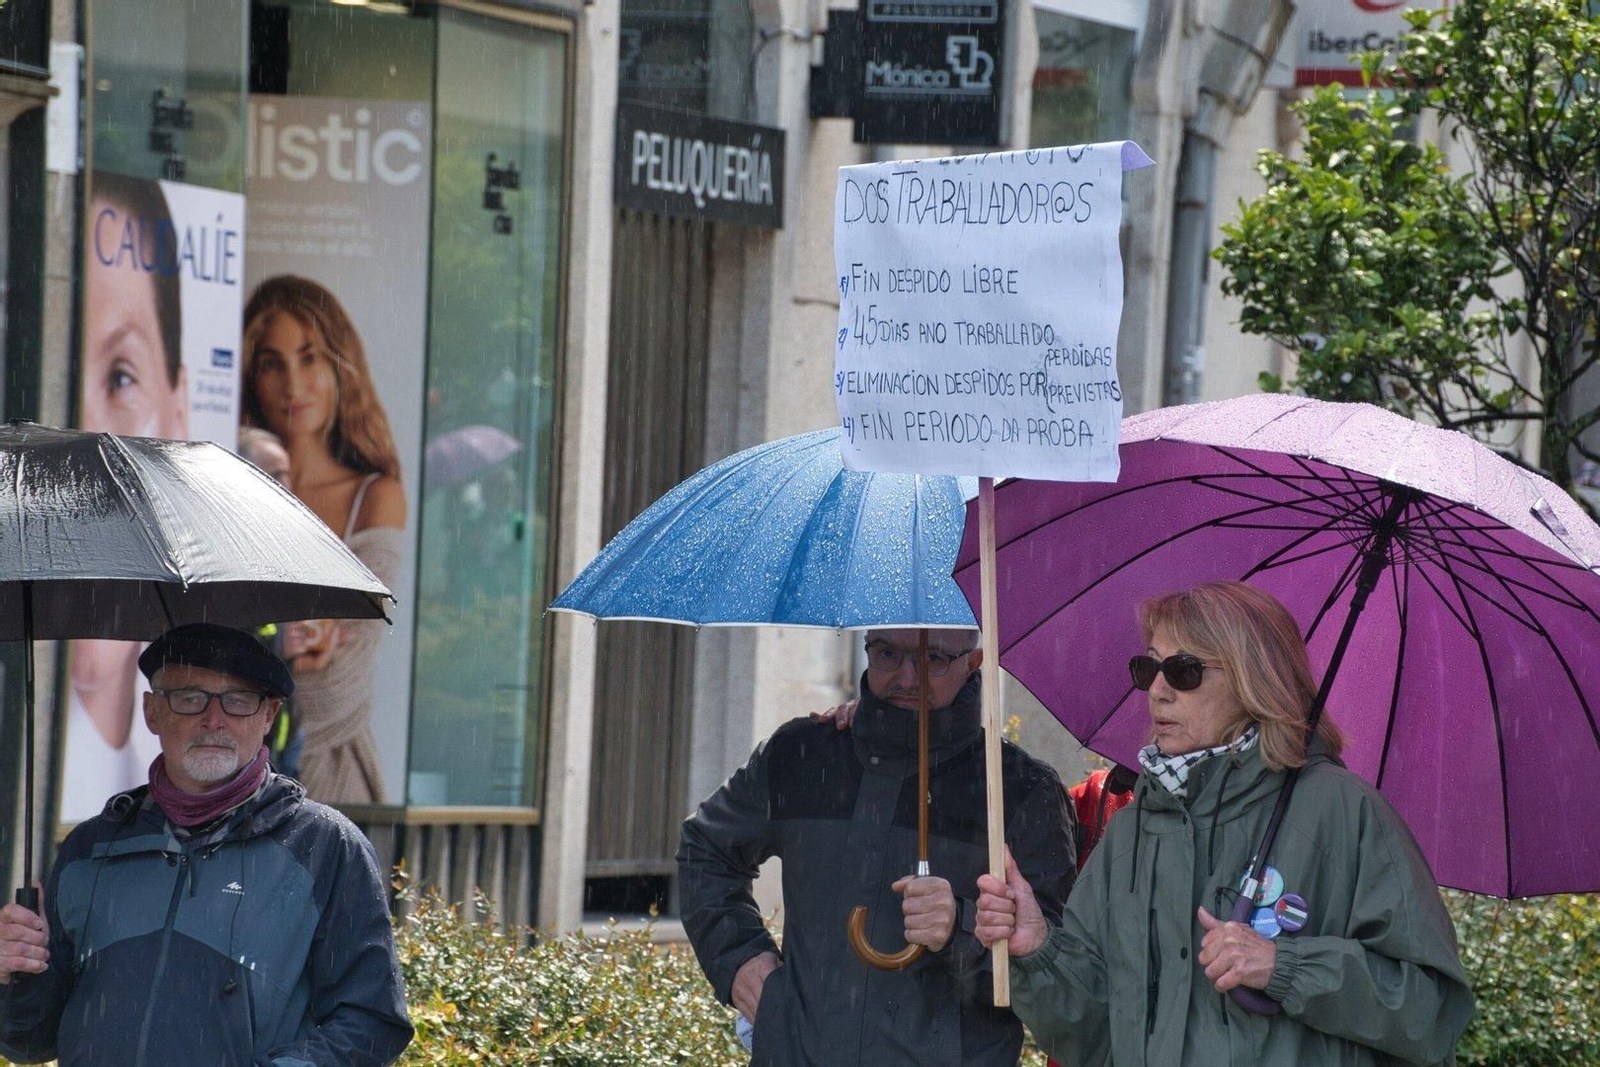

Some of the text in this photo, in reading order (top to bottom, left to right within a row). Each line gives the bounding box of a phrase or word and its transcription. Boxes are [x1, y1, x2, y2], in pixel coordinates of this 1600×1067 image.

[865, 60, 949, 88] Mónica
[630, 130, 773, 208] PELUQUERÍA
[844, 171, 1094, 225] DOS TRABALLADOR@S
[95, 208, 237, 286] CAUDALÍE
[888, 268, 950, 293] DESPIDO
[919, 322, 947, 344] ANO
[954, 320, 1055, 346] TRABALLADO
[1019, 371, 1047, 398] POR
[1049, 380, 1122, 406] PREVISTAS
[861, 410, 894, 441] FIN
[905, 410, 994, 444] PERIODO
[1002, 417, 1021, 442] DA
[1027, 418, 1094, 447] PROBA
